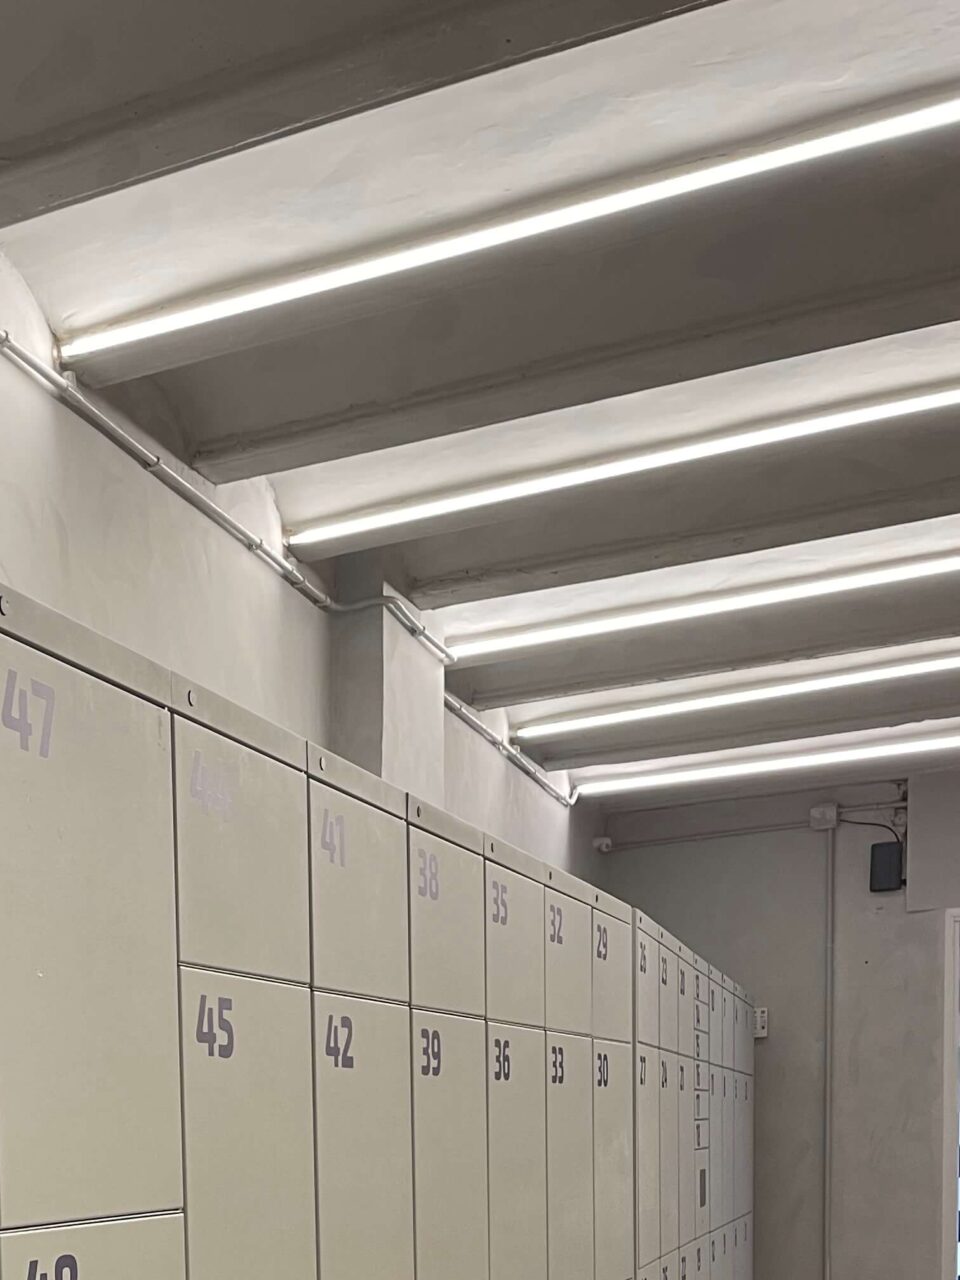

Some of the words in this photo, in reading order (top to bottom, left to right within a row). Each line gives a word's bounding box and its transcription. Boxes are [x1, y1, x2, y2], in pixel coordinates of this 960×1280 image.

[1, 669, 55, 758] 47
[320, 808, 345, 868] 41
[417, 848, 439, 901] 38
[491, 880, 508, 926] 35
[549, 904, 563, 945] 32
[596, 925, 608, 961] 29
[196, 995, 234, 1059] 45
[325, 1014, 354, 1069] 42
[421, 1029, 441, 1077] 39
[494, 1038, 510, 1081] 36
[551, 1046, 564, 1084] 33
[597, 1053, 608, 1087] 30
